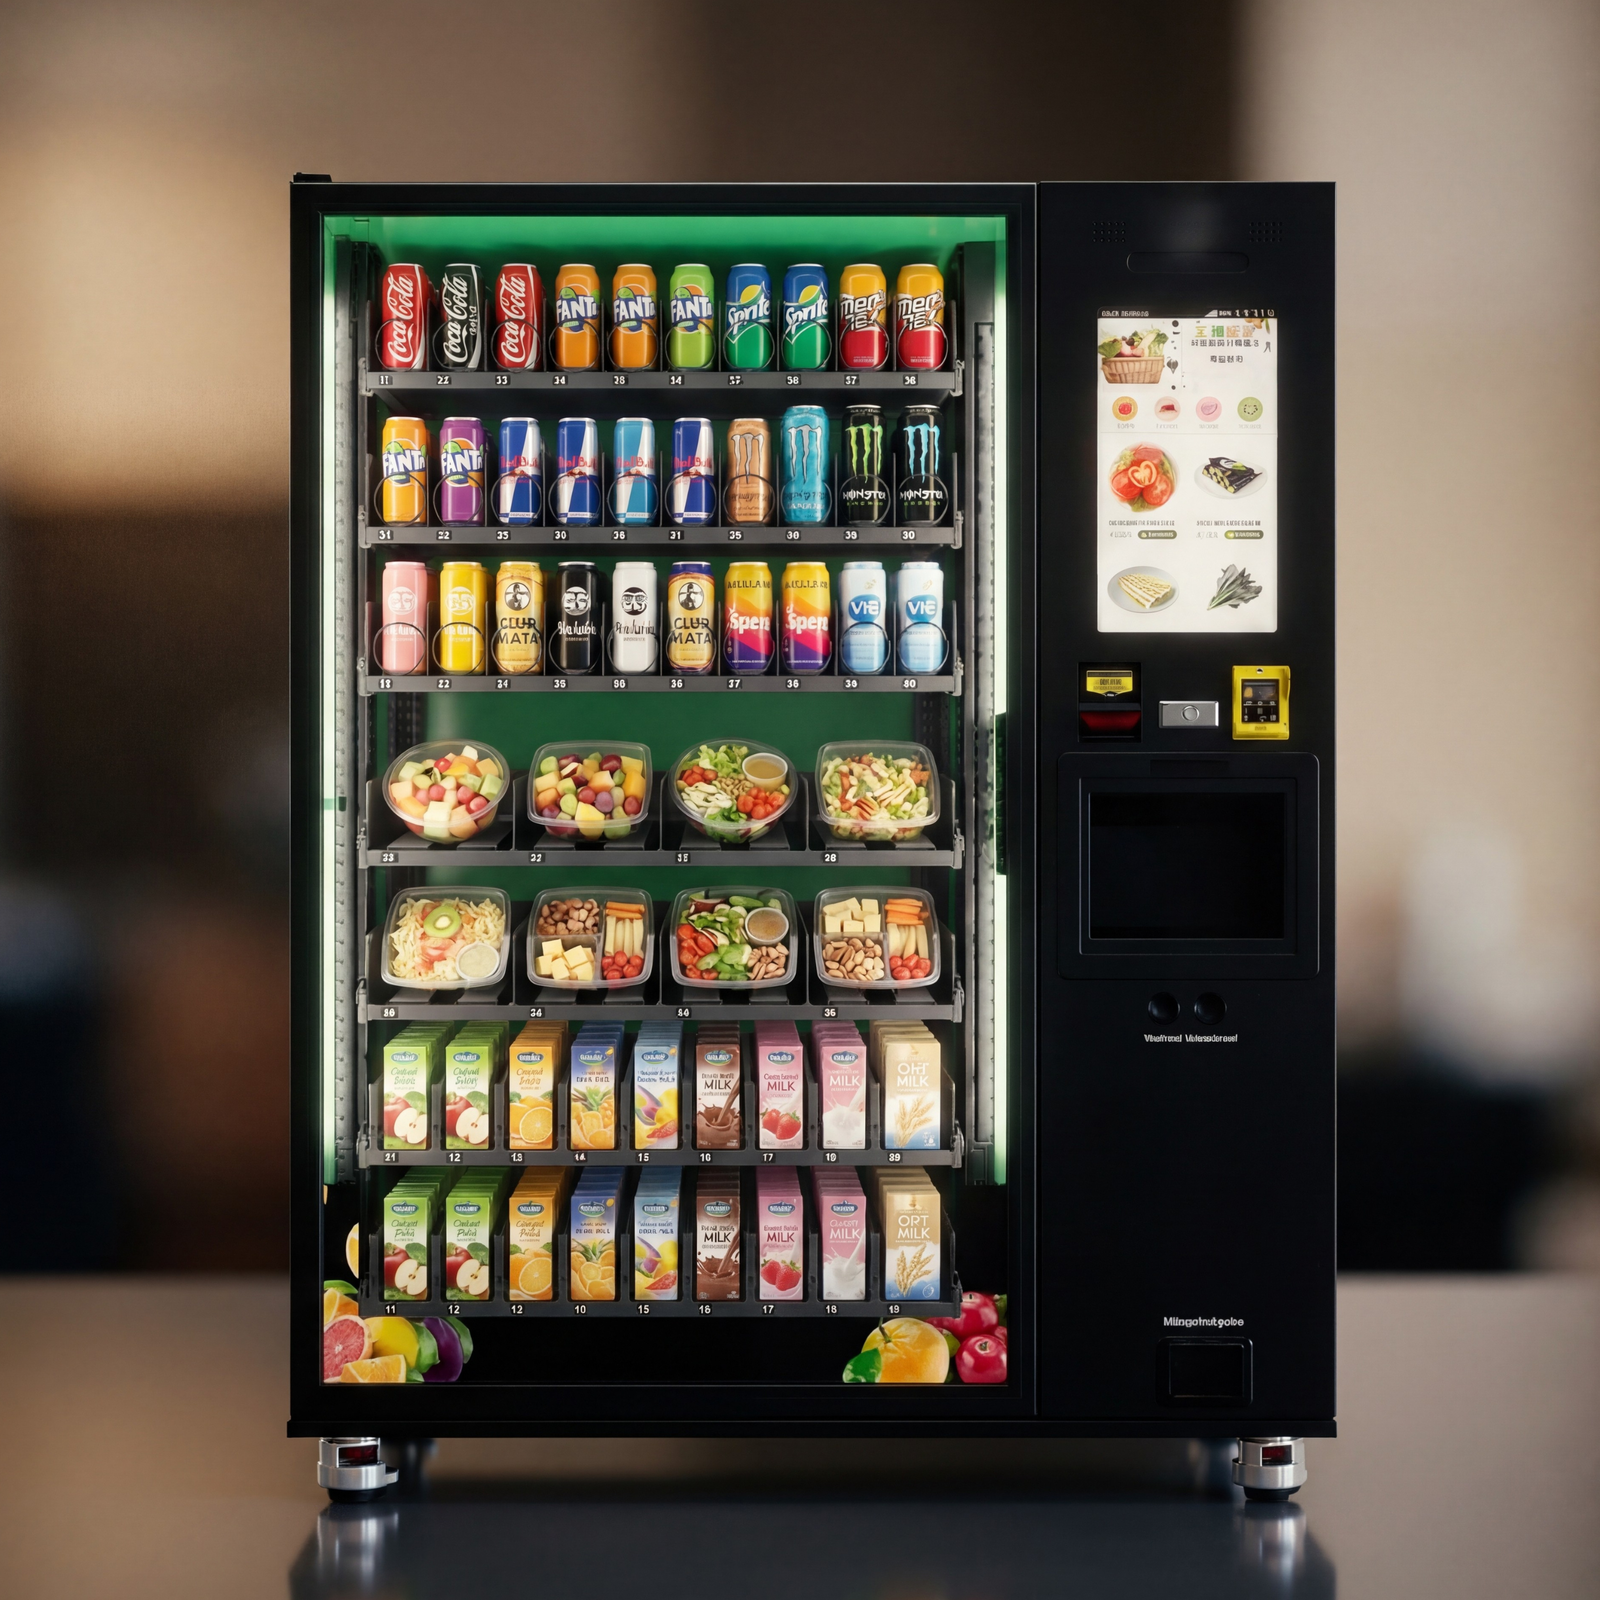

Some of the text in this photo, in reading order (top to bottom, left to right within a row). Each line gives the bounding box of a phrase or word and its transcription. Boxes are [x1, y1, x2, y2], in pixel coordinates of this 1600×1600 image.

[387, 272, 414, 362] Coca Cola
[442, 272, 468, 362] Coca Cola
[500, 273, 526, 362] Coca Cola
[902, 530, 915, 540] 30
[704, 1079, 731, 1090] MILK
[830, 1075, 860, 1087] MILK
[897, 1076, 929, 1087] MILK
[767, 1081, 795, 1092] MILK
[448, 1152, 461, 1162] 12
[637, 1152, 650, 1162] 15
[704, 1232, 731, 1242] MILK
[767, 1232, 795, 1242] MILK
[830, 1228, 860, 1239] MILK
[897, 1227, 930, 1239] MILK
[385, 1304, 396, 1314] 11
[448, 1304, 460, 1314] 12
[510, 1304, 523, 1314] 12
[574, 1304, 586, 1314] 10
[637, 1304, 650, 1314] 15
[762, 1304, 774, 1314] 17
